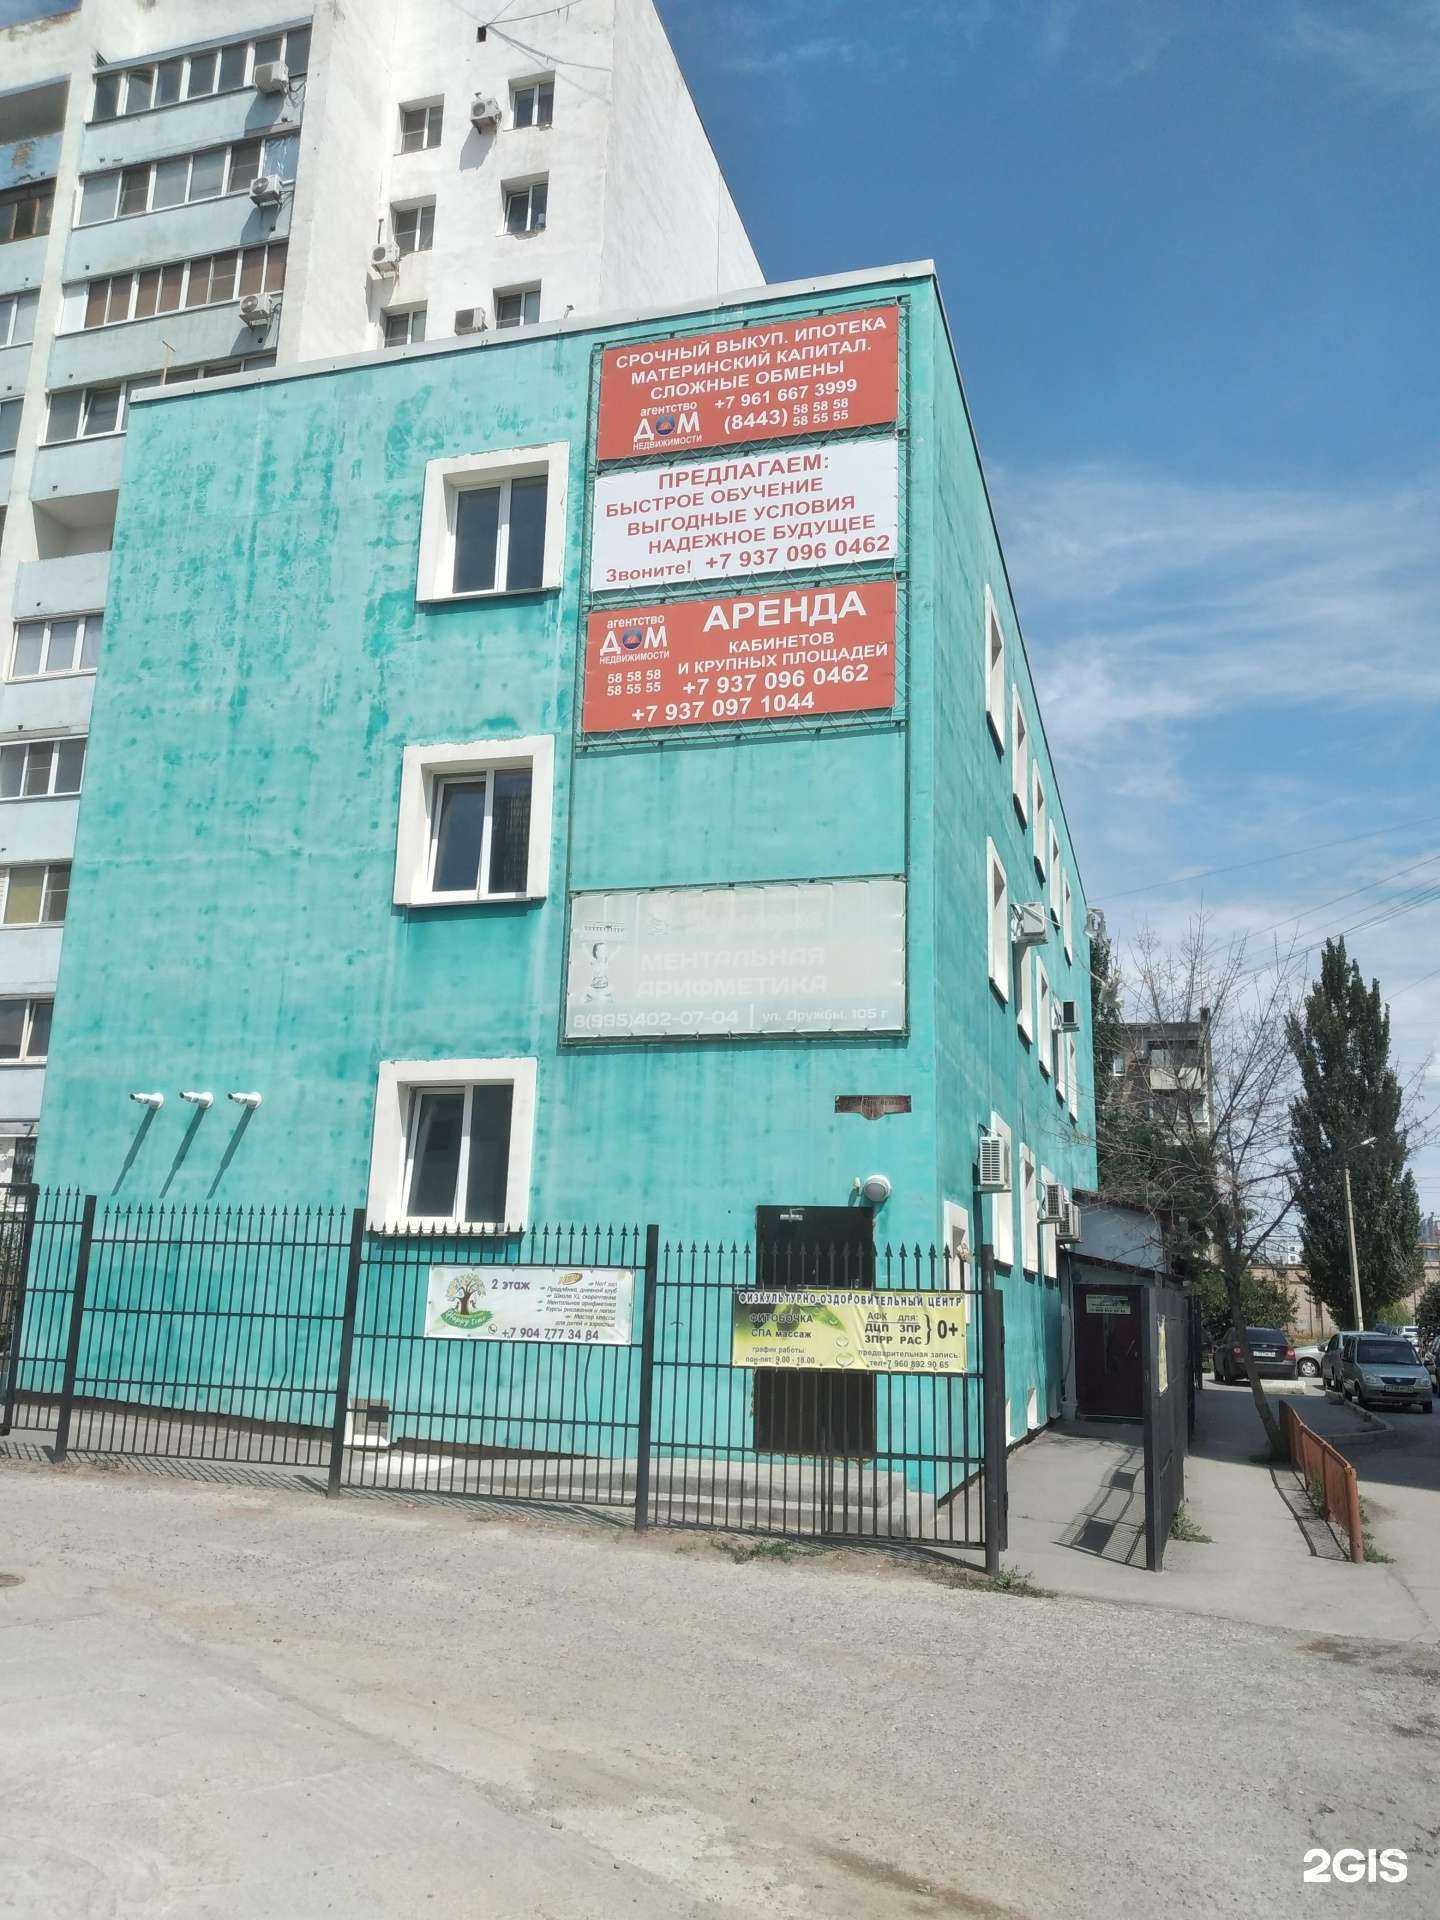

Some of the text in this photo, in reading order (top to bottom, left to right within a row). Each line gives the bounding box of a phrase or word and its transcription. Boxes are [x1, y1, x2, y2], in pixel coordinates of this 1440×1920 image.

[616, 316, 887, 368] СРОЧНЫЙ ВЫКУП. ИПОТЕКА
[631, 339, 872, 384] МАТЕРИНСКИЙ КАПИТАЛ.
[650, 361, 844, 400] СЛОЖНЫЕ ОБМЕНЫ
[715, 379, 857, 409] +7 961 667 3999
[640, 400, 697, 416] агентство
[793, 397, 848, 415] 58 58 58
[724, 408, 788, 434] (8443)
[793, 410, 848, 427] 58 55 55
[633, 434, 702, 451] НЕДВИЖИМОСТИ
[659, 454, 829, 489] ПРЕДЛАГАЕМ:
[606, 478, 823, 517] БЫСТРОЕ ОБУЧЕНИЕ
[627, 496, 855, 536] ВЫГОДНЫЕ УСЛОВИЯ
[648, 514, 875, 554] НАДЕЖНОЕ БУДУЩЕЕ
[606, 535, 890, 582] Звоните! +7 937 096 0462
[607, 615, 665, 628] агентство
[703, 591, 867, 632] АРЕНДА
[729, 632, 834, 654] КАБИНЕТОВ
[599, 650, 669, 664] НЕДВИЖИМОСТИ
[678, 641, 888, 675] И КРУПНЫХ ПЛОЩАДЕЙ
[607, 669, 661, 683] 58 58 58
[683, 664, 869, 696] +7 937 096 0462
[607, 681, 660, 696] 58 55 55
[632, 691, 815, 722] +7 937 097 1044
[641, 947, 825, 971] МЕНТАЛЬНАЯ
[636, 976, 827, 997] АРИФМЕТИКА
[851, 1008, 876, 1020] 105
[492, 1279, 530, 1290] 2 этаж
[928, 1297, 962, 1307] ЦЕНТР
[867, 1312, 887, 1321] АФК
[502, 1328, 598, 1341] +7 904 777 34 84
[865, 1324, 921, 1333] ДЦП ЗПР
[865, 1335, 893, 1343] ЗПРР
[938, 1320, 958, 1339] 0+
